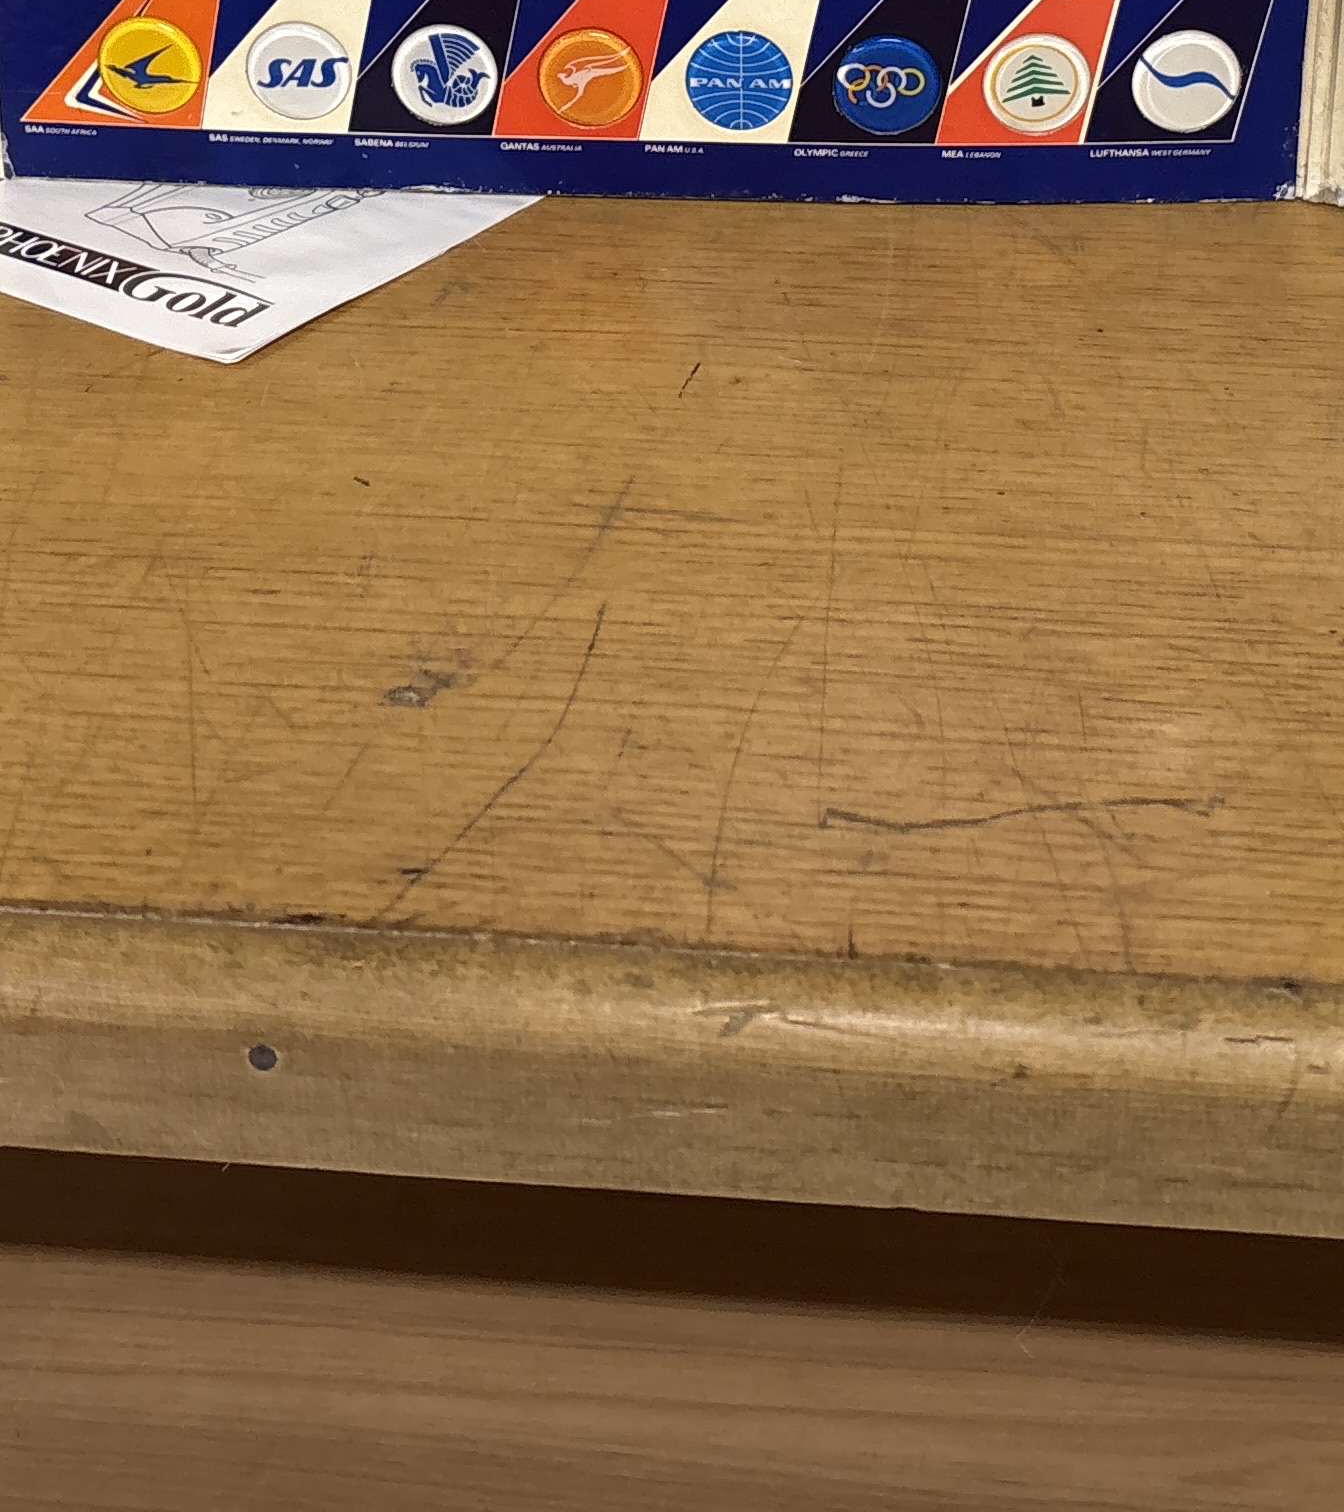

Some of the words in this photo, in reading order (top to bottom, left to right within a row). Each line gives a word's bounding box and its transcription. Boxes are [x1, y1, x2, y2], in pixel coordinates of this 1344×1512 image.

[257, 57, 348, 88] SAS
[689, 78, 740, 89] PAN
[742, 78, 791, 89] AM
[209, 133, 228, 142] SAS
[354, 138, 394, 147] SABENA
[500, 142, 540, 151] QANTAS
[645, 144, 666, 153] PAN
[666, 144, 683, 153] AM
[794, 148, 838, 157] OLYMPIC
[1090, 148, 1149, 158] LUFTHANSA
[941, 150, 964, 158] MEA
[122, 271, 273, 328] Gold
